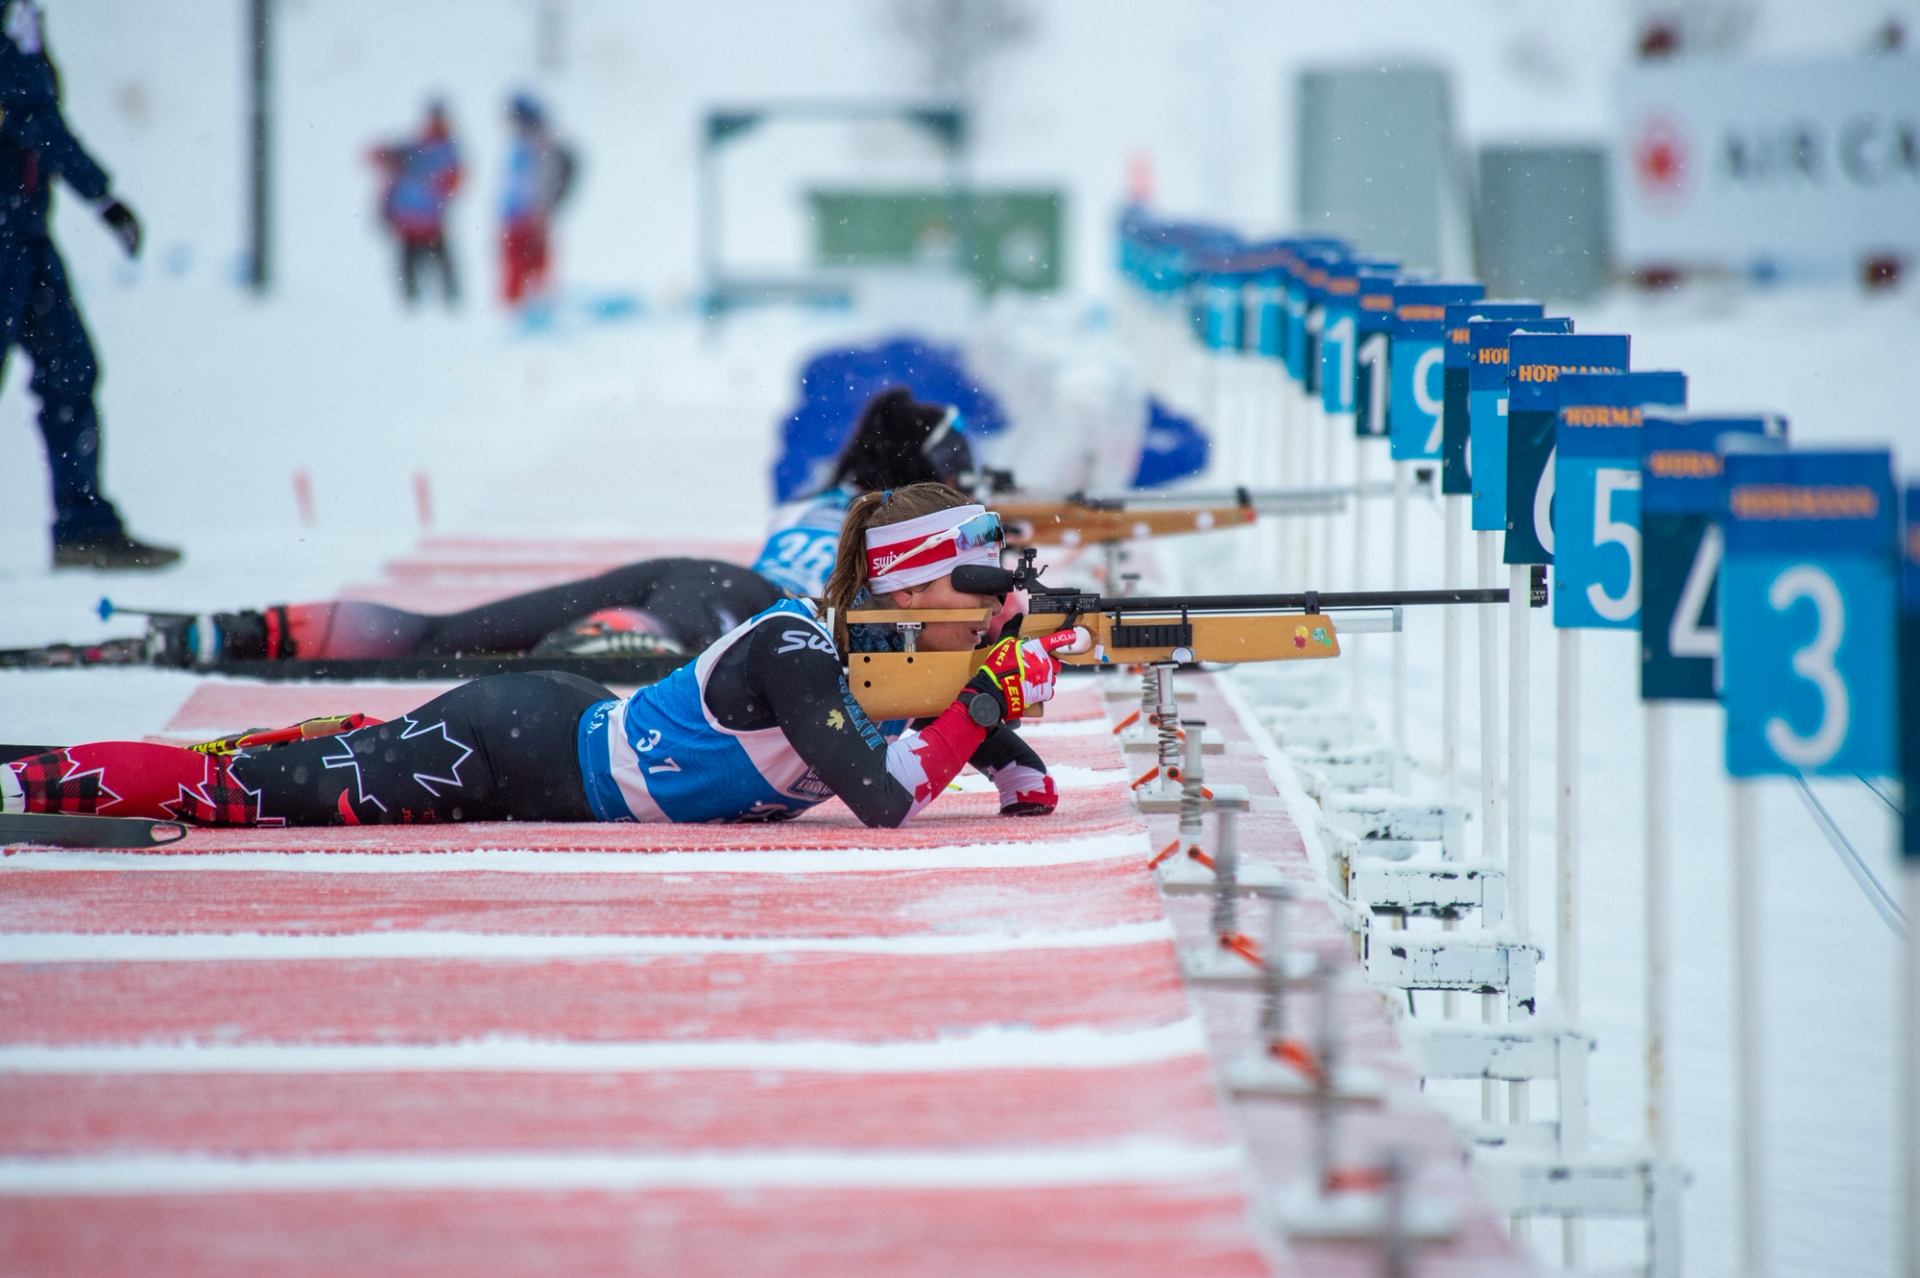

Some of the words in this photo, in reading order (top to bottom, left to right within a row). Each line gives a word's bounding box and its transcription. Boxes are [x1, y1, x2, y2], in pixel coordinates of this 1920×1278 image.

[1586, 467, 1642, 622] 5
[1003, 675, 1021, 711] LEKI
[1766, 563, 1853, 767] 3
